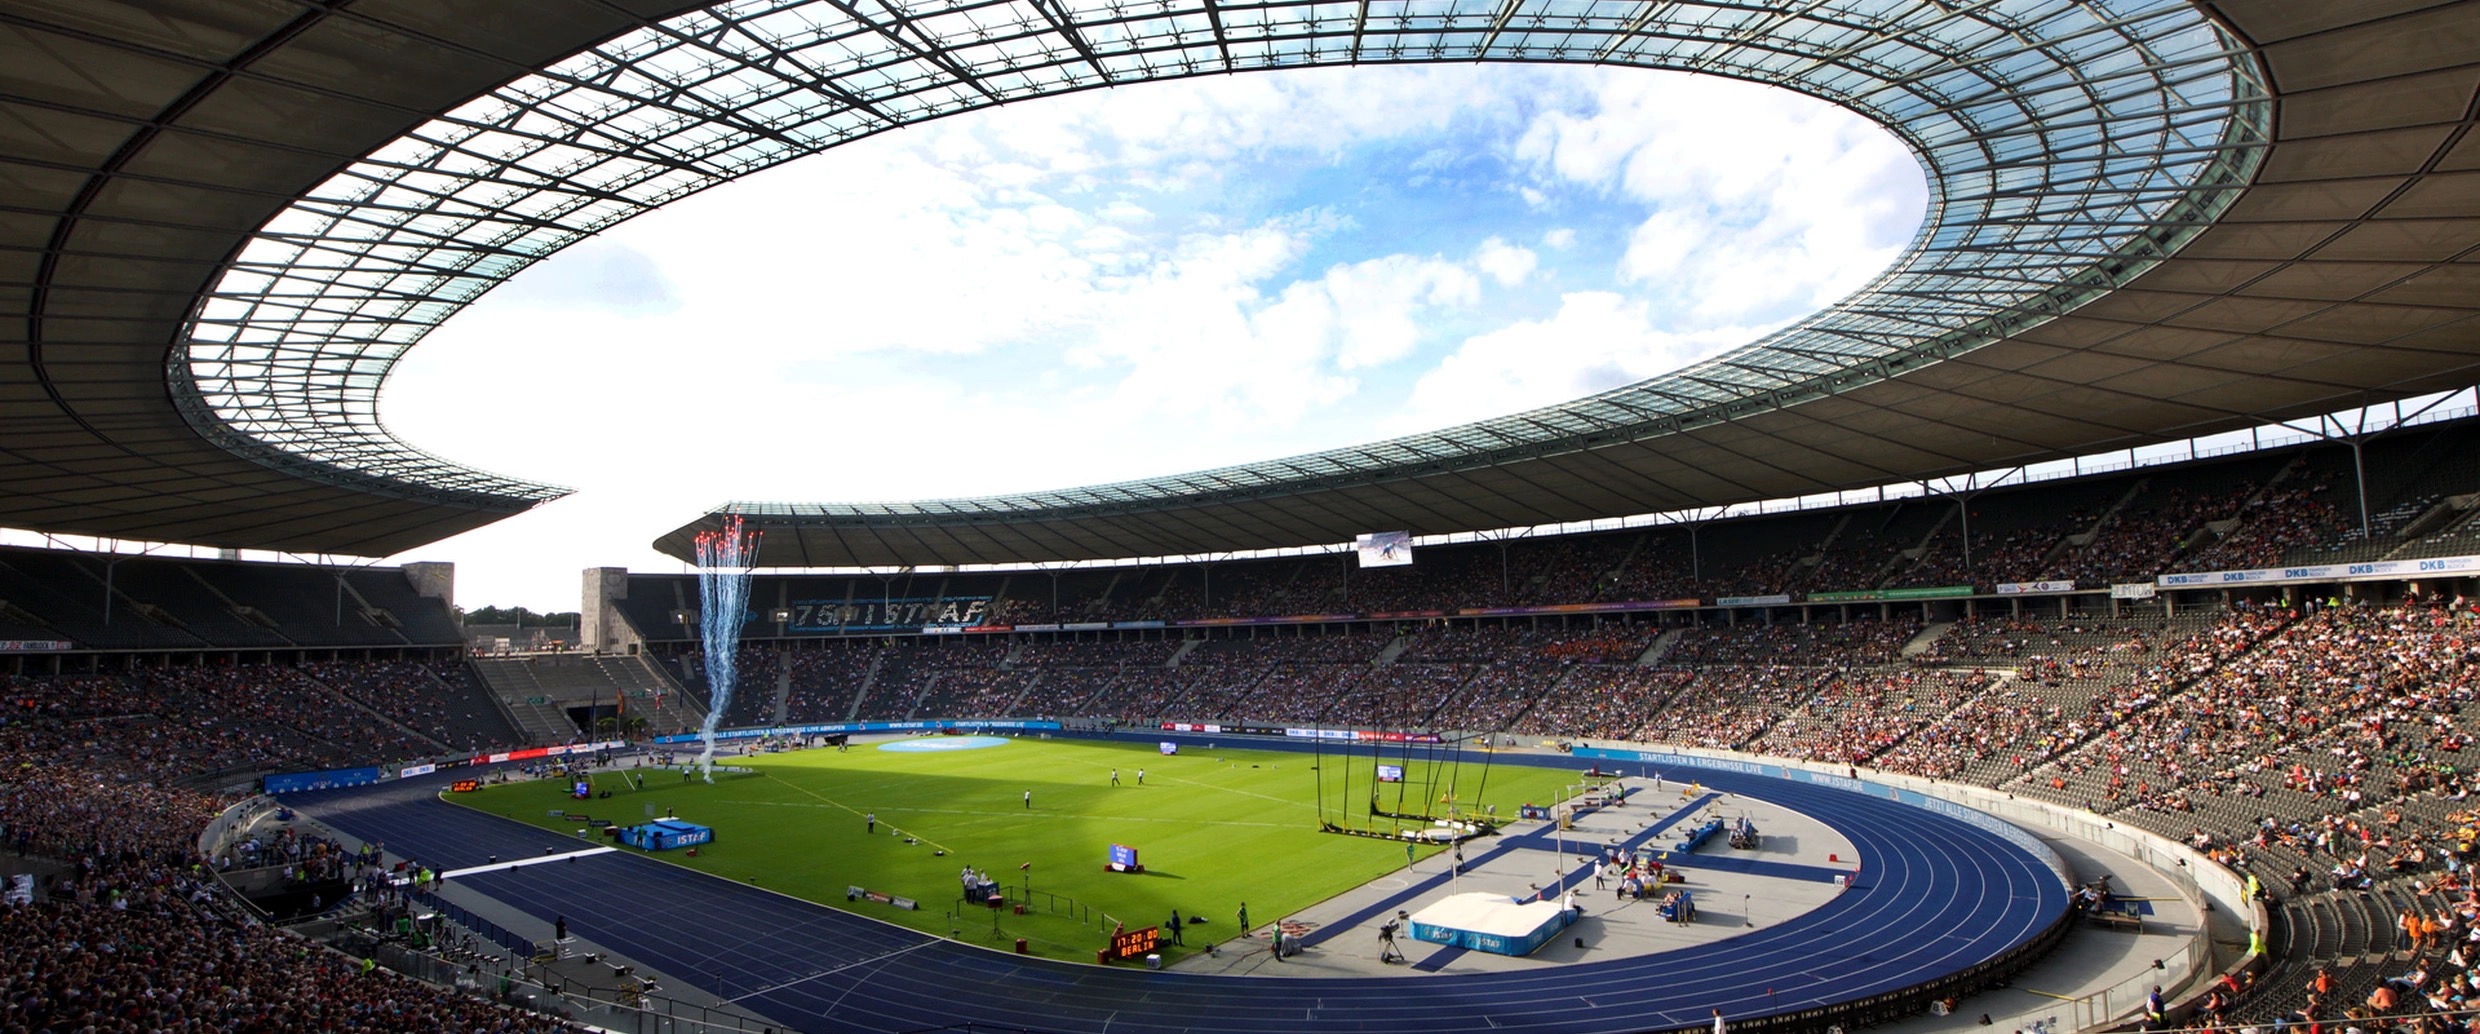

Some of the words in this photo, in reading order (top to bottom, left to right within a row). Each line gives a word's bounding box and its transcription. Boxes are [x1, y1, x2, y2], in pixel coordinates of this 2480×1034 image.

[2350, 565, 2373, 574] DKB
[2420, 560, 2445, 571] DKB
[2167, 575, 2188, 584] DKB
[2223, 572, 2245, 581] DKB
[2285, 569, 2308, 578] DKB
[728, 729, 765, 737] STARTLISTEN
[1639, 752, 1687, 765] STARTLISTEN
[1689, 756, 1695, 766] &
[1697, 757, 1744, 772] ERGEBNISSE
[1745, 763, 1763, 775] LIVE
[1811, 772, 1863, 792] WWW.ISTAF.DE
[1924, 796, 1945, 812] JETZT
[1945, 800, 1963, 816] ALLE
[1964, 807, 2003, 834] STARTLISTEN
[677, 832, 706, 845] ISTAF
[1117, 929, 1158, 948] 17:20:00
[1121, 940, 1154, 957] BERLIN
